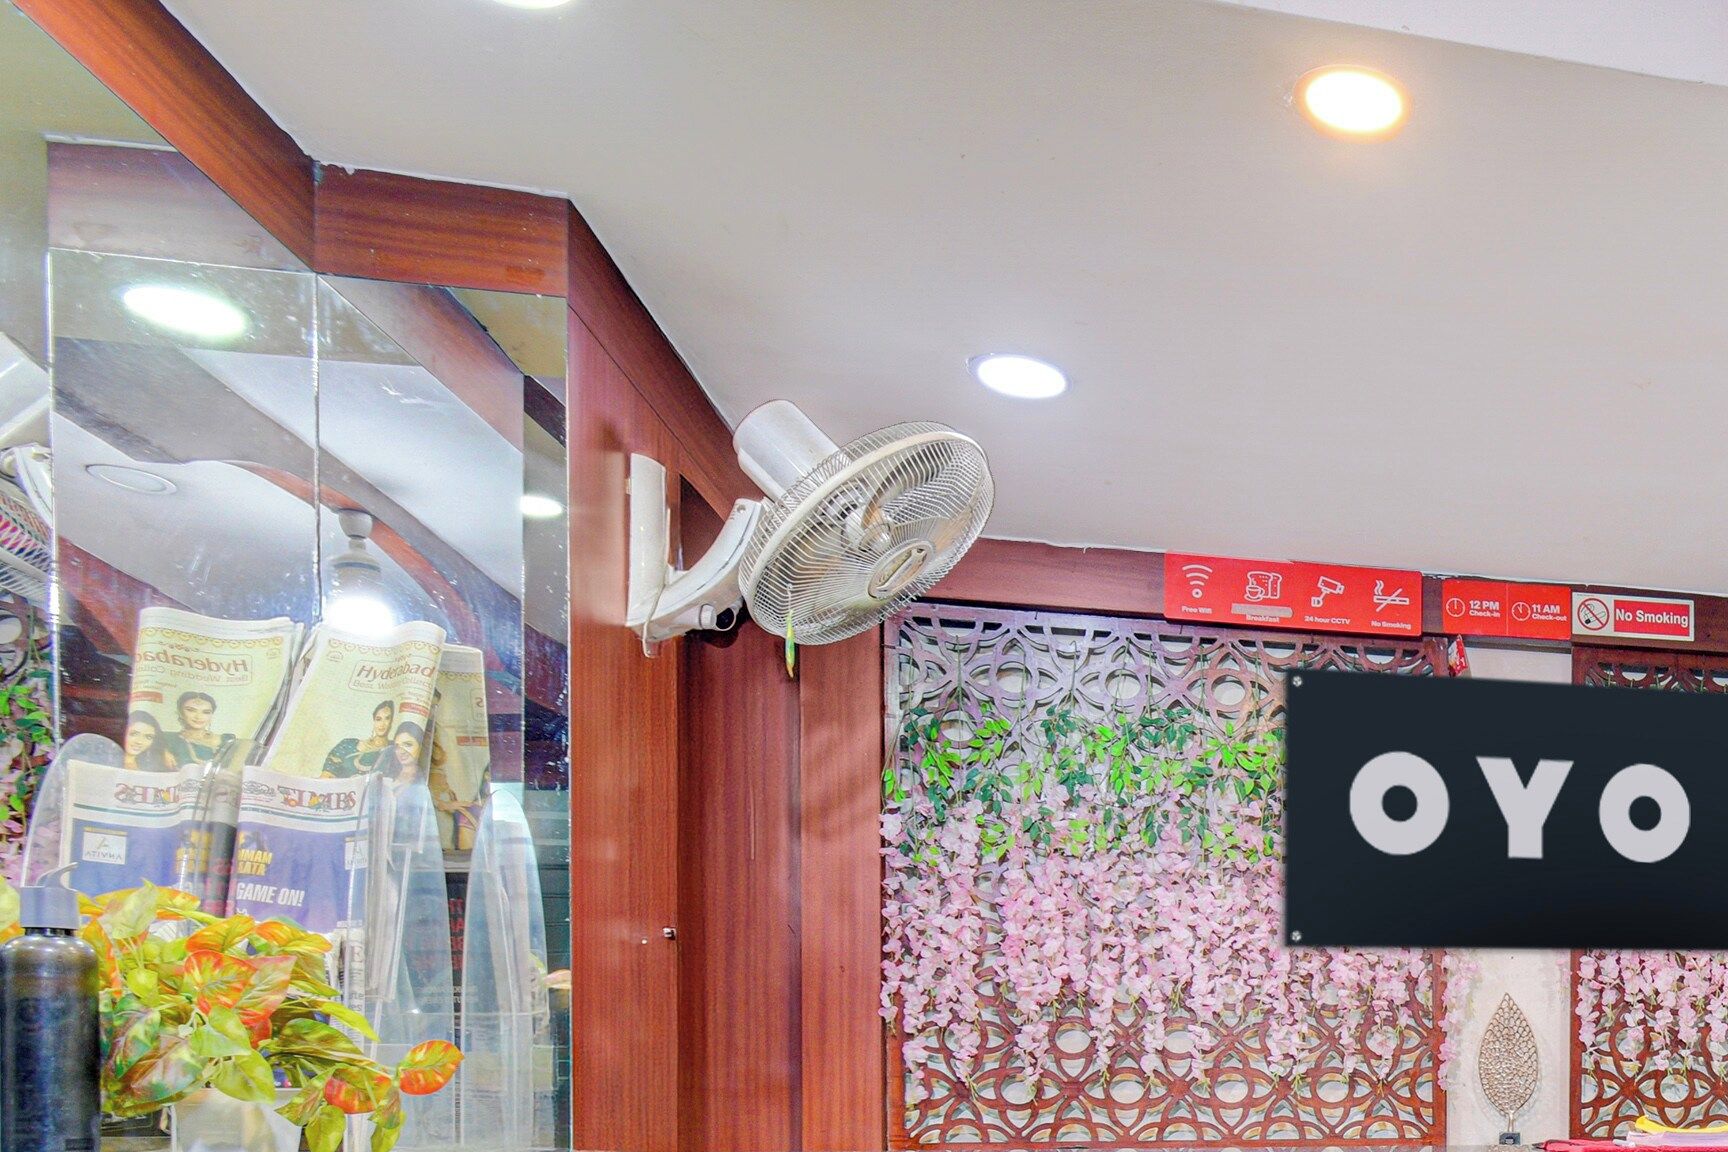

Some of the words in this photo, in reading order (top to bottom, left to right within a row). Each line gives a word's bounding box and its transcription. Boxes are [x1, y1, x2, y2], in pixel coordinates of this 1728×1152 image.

[1181, 605, 1198, 614] Free
[1469, 600, 1481, 610] 12
[1482, 601, 1500, 611] PM
[1532, 603, 1541, 613] 11
[1542, 605, 1560, 614] AM
[1469, 609, 1501, 618] Check-in
[1532, 613, 1567, 622] Check-out
[1615, 608, 1633, 622] No
[1635, 610, 1689, 629] Smoking
[1304, 615, 1314, 623] 24
[1315, 616, 1330, 624] hour
[1331, 617, 1351, 625] CCTV
[1371, 619, 1381, 627] No
[1382, 621, 1411, 631] Smoking
[1350, 751, 1690, 863] OYO
[236, 882, 277, 904] GAME
[278, 888, 305, 907] ON!
